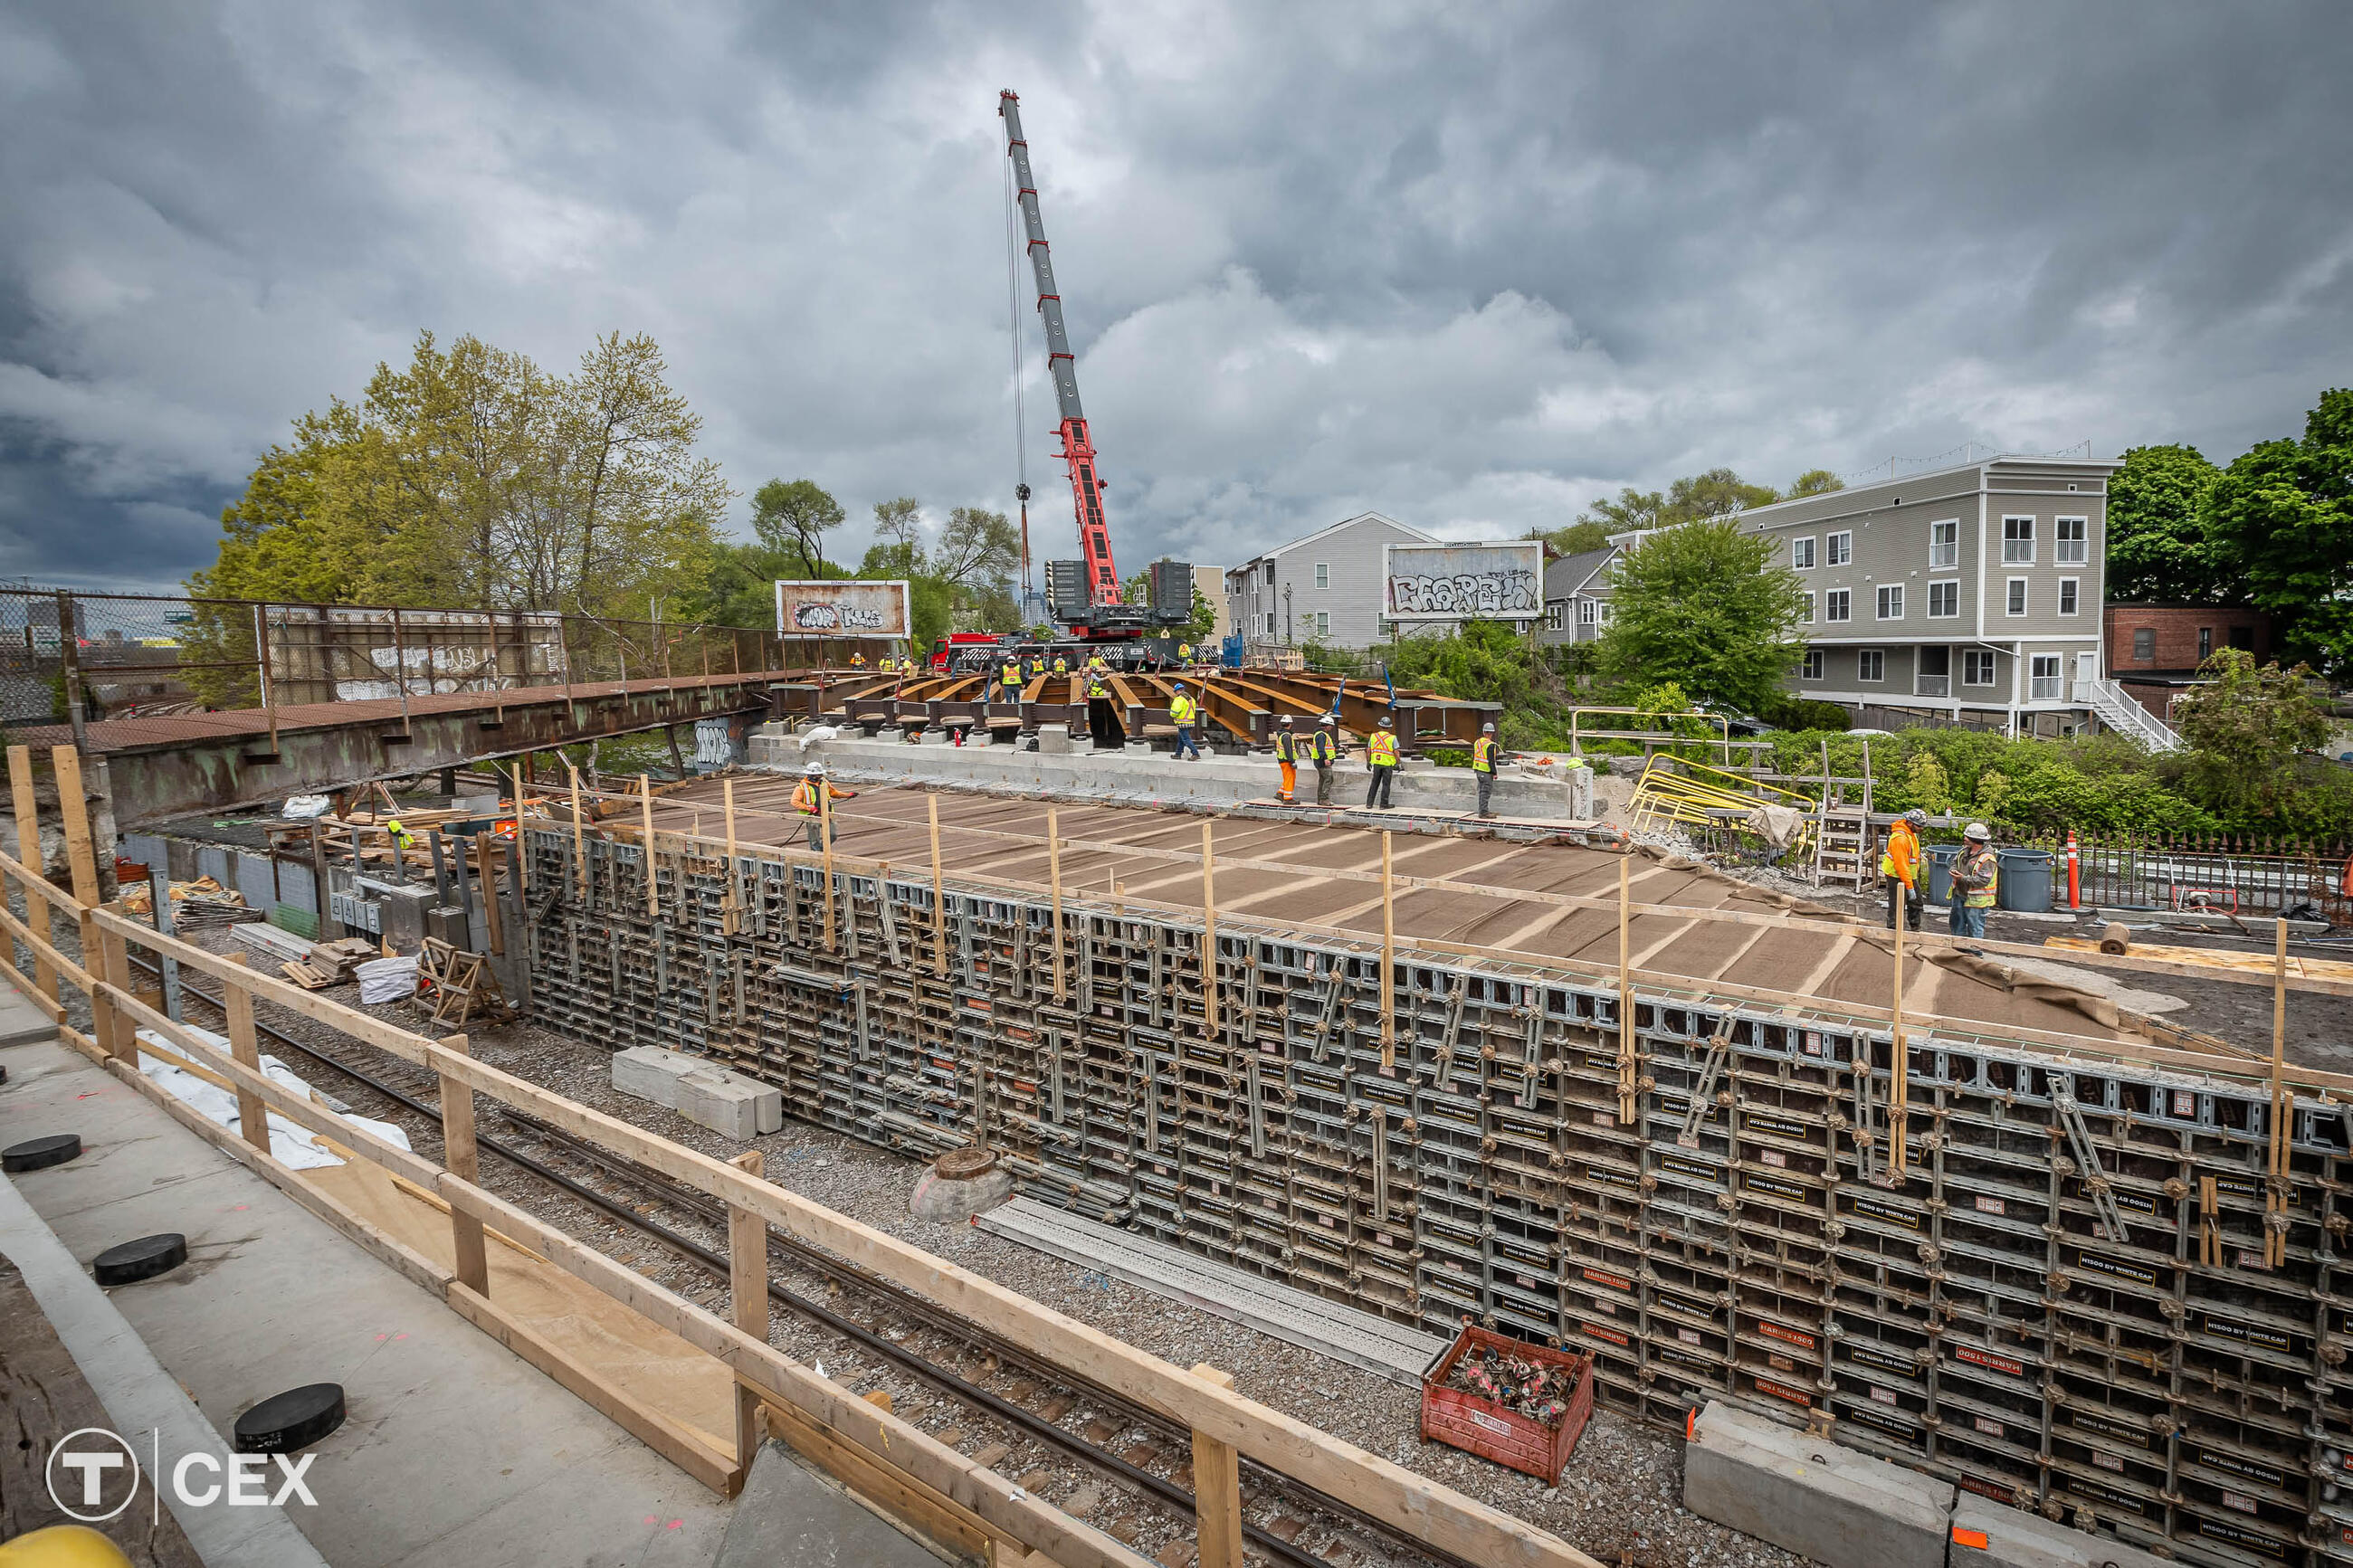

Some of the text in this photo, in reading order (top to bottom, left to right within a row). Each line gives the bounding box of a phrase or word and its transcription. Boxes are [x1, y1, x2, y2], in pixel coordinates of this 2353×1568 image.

[1748, 1179, 1765, 1187] H1500
[2129, 1197, 2153, 1209] H1500
[1857, 1201, 1875, 1211] H1500
[1885, 1209, 1904, 1218] WHITE
[2081, 1257, 2153, 1279] H1500 BY WHITE CAP
[1684, 1306, 1700, 1315] WHITE
[2207, 1322, 2231, 1333] H1500
[2232, 1327, 2244, 1336] BY
[2270, 1334, 2287, 1343] CAP
[1866, 1355, 1885, 1364] WHITE
[1959, 1350, 2020, 1371] HARRIS 1500
[1895, 1362, 1913, 1370] H1500
[1866, 1415, 1885, 1425] WHITE
[1894, 1423, 1912, 1434] H1500
[2098, 1422, 2108, 1431] BY
[2109, 1425, 2131, 1437] WHITE
[2131, 1431, 2146, 1441] CAP
[2202, 1454, 2280, 1482] H1500 BY WHITE CAP
[2071, 1483, 2085, 1492] CAP
[2086, 1487, 2107, 1499] WHITE
[2108, 1494, 2119, 1502] BY
[2202, 1523, 2280, 1548] H1500 BY WHITE CAP
